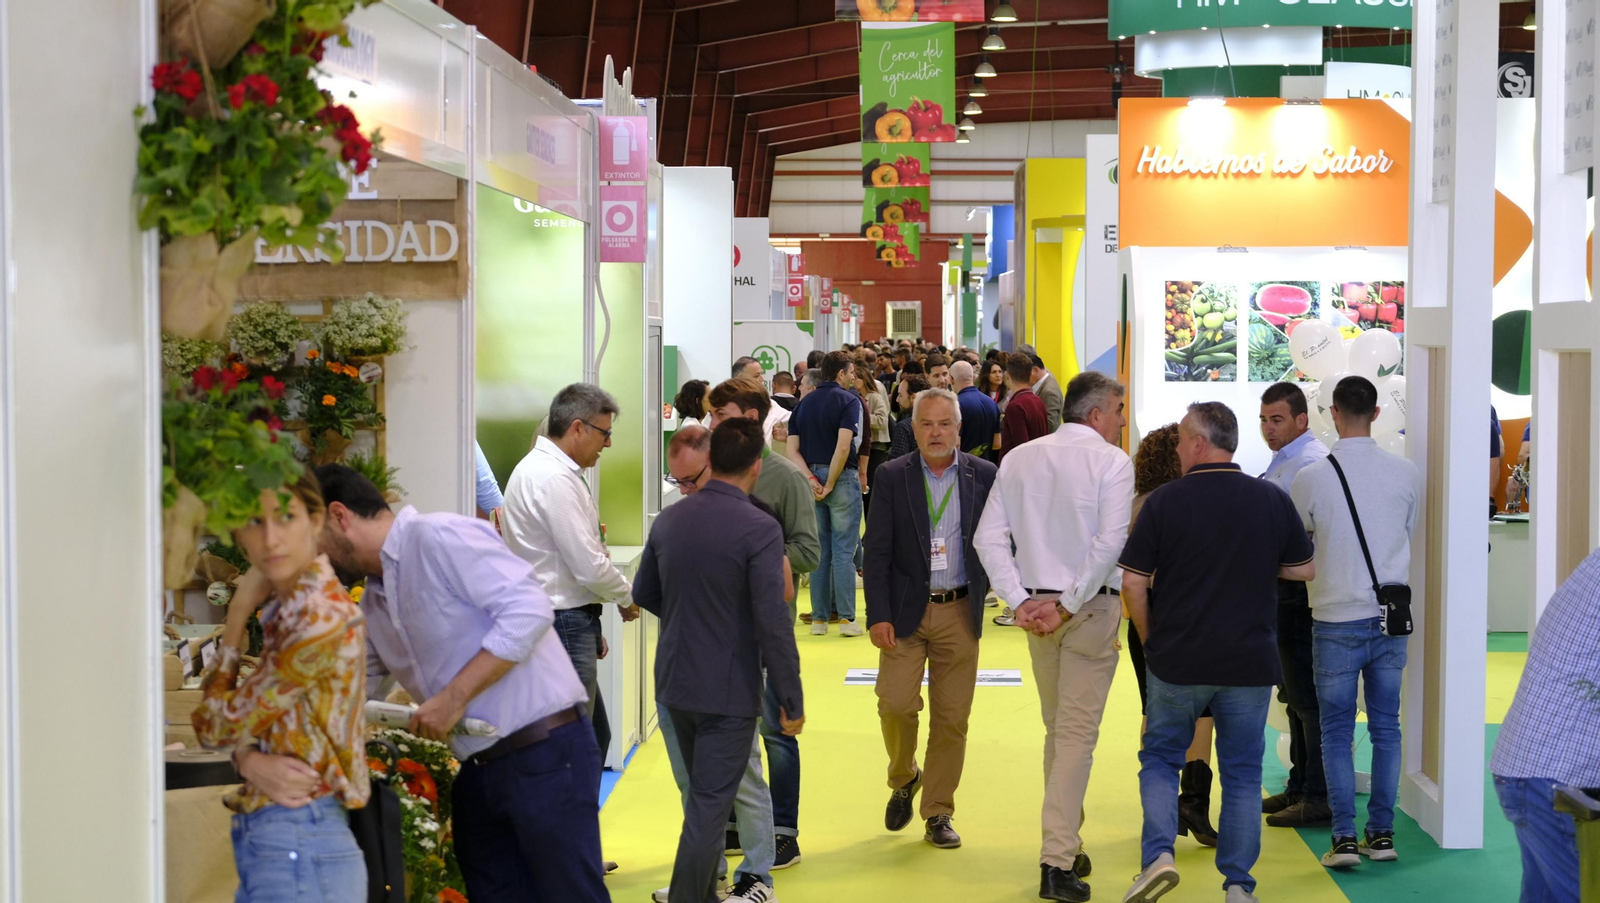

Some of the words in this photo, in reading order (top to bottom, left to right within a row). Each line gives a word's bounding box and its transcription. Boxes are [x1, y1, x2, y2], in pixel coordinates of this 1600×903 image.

[879, 41, 919, 73] Cerca
[923, 39, 943, 62] del
[882, 61, 943, 98] agricultor
[1137, 145, 1267, 174] Hablemos
[1312, 145, 1394, 174] Sabor
[734, 276, 756, 286] HAL
